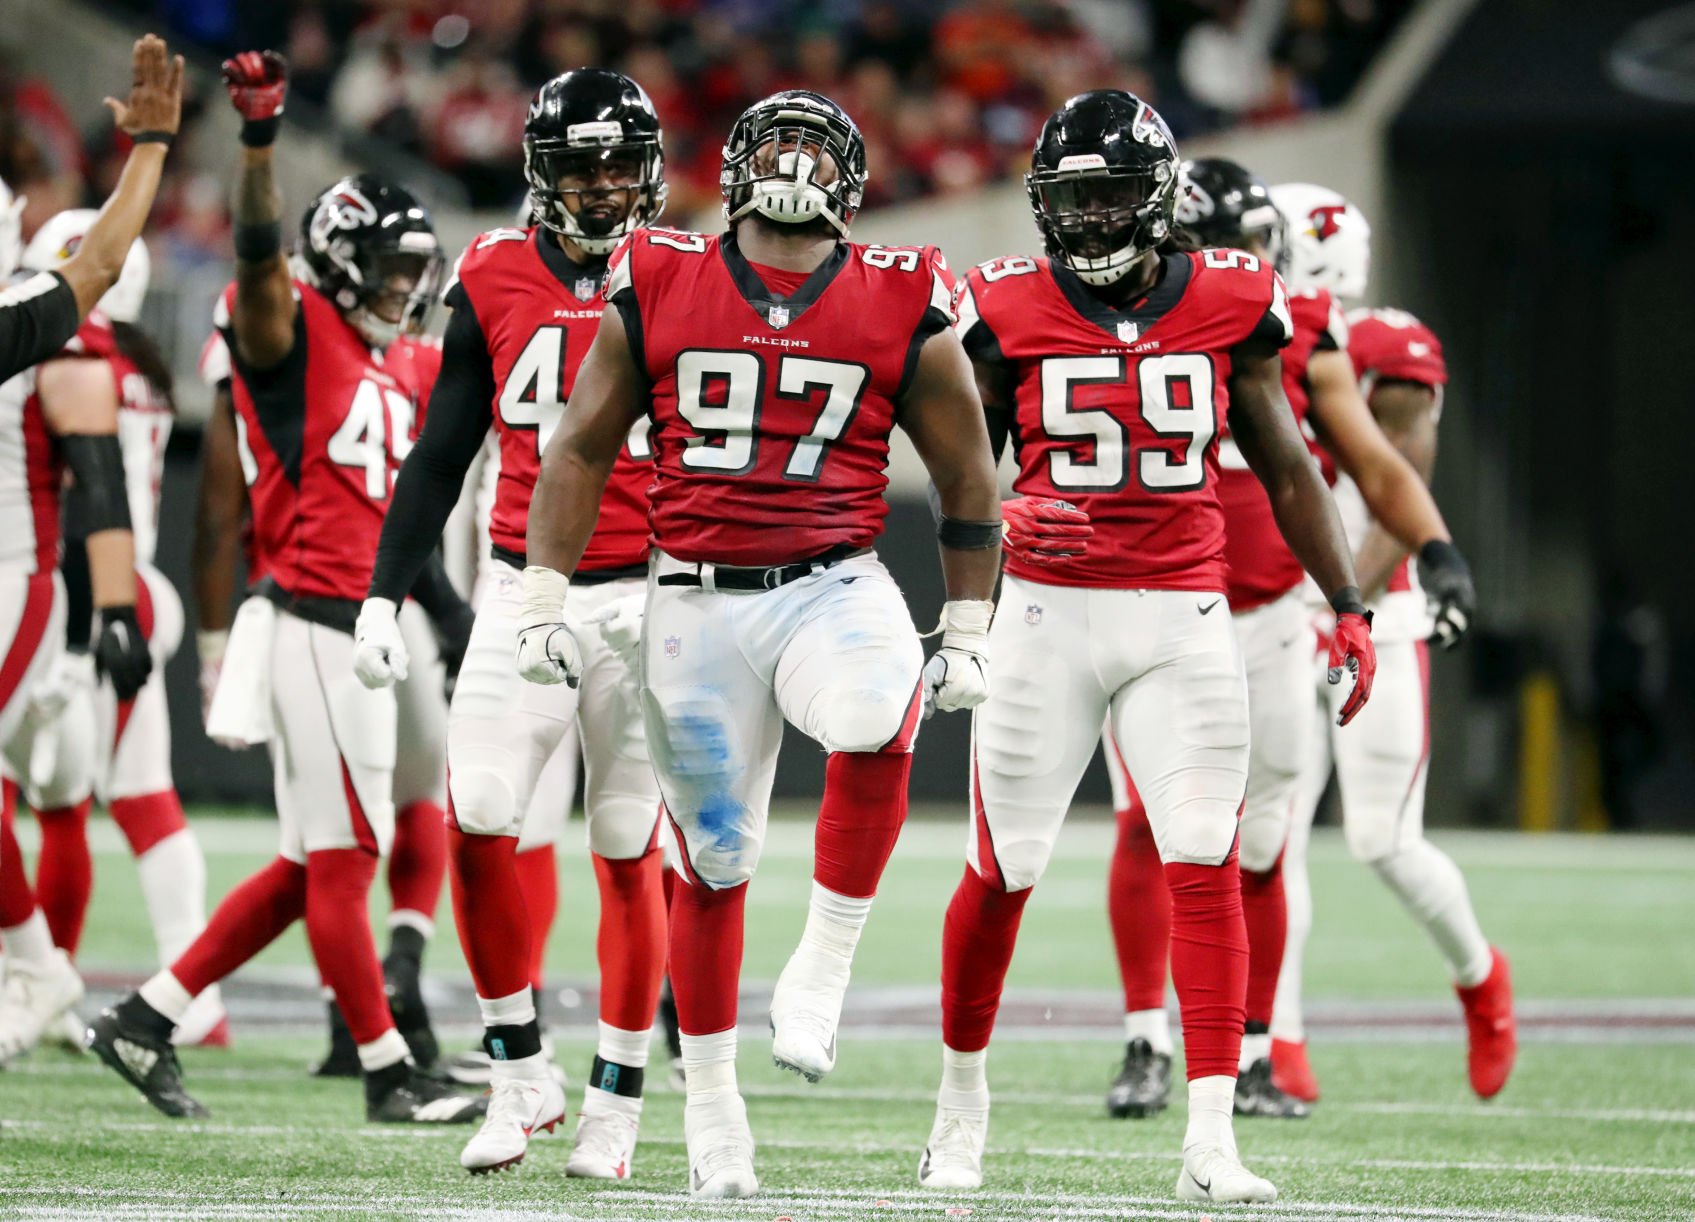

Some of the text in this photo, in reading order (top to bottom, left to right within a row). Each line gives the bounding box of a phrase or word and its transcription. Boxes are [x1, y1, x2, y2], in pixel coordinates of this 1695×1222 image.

[742, 335, 809, 348] FALCONS
[675, 348, 872, 482] 97
[1040, 352, 1216, 493] 59
